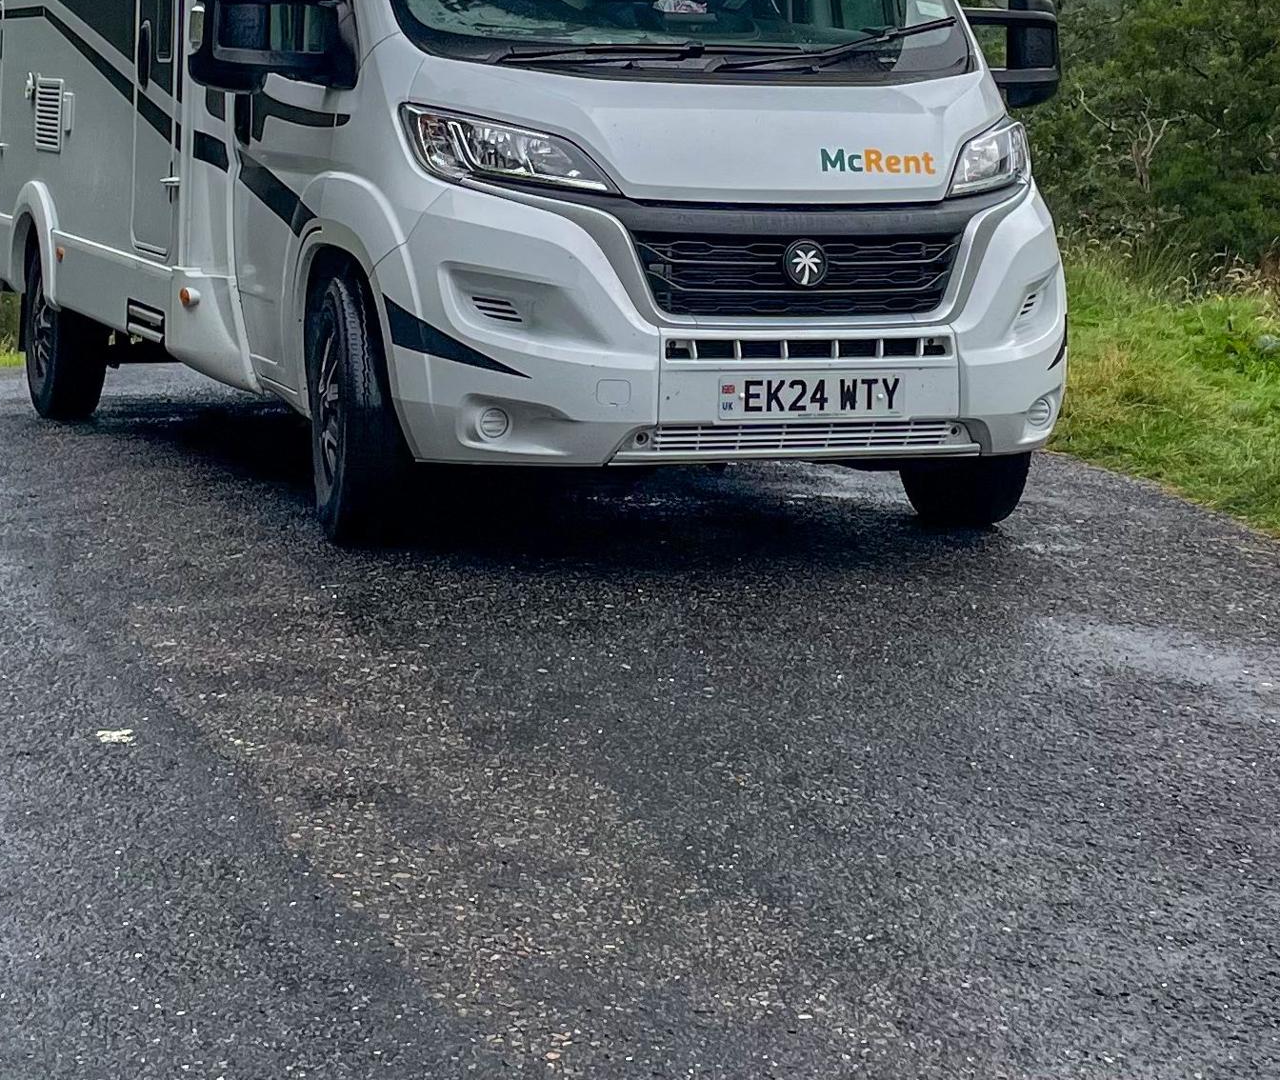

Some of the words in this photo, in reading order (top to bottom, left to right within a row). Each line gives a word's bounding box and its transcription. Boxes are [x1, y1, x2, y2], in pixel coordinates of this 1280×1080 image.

[820, 148, 936, 175] McRent
[722, 401, 734, 411] UK
[744, 379, 829, 412] EK24
[840, 377, 901, 411] WTY
